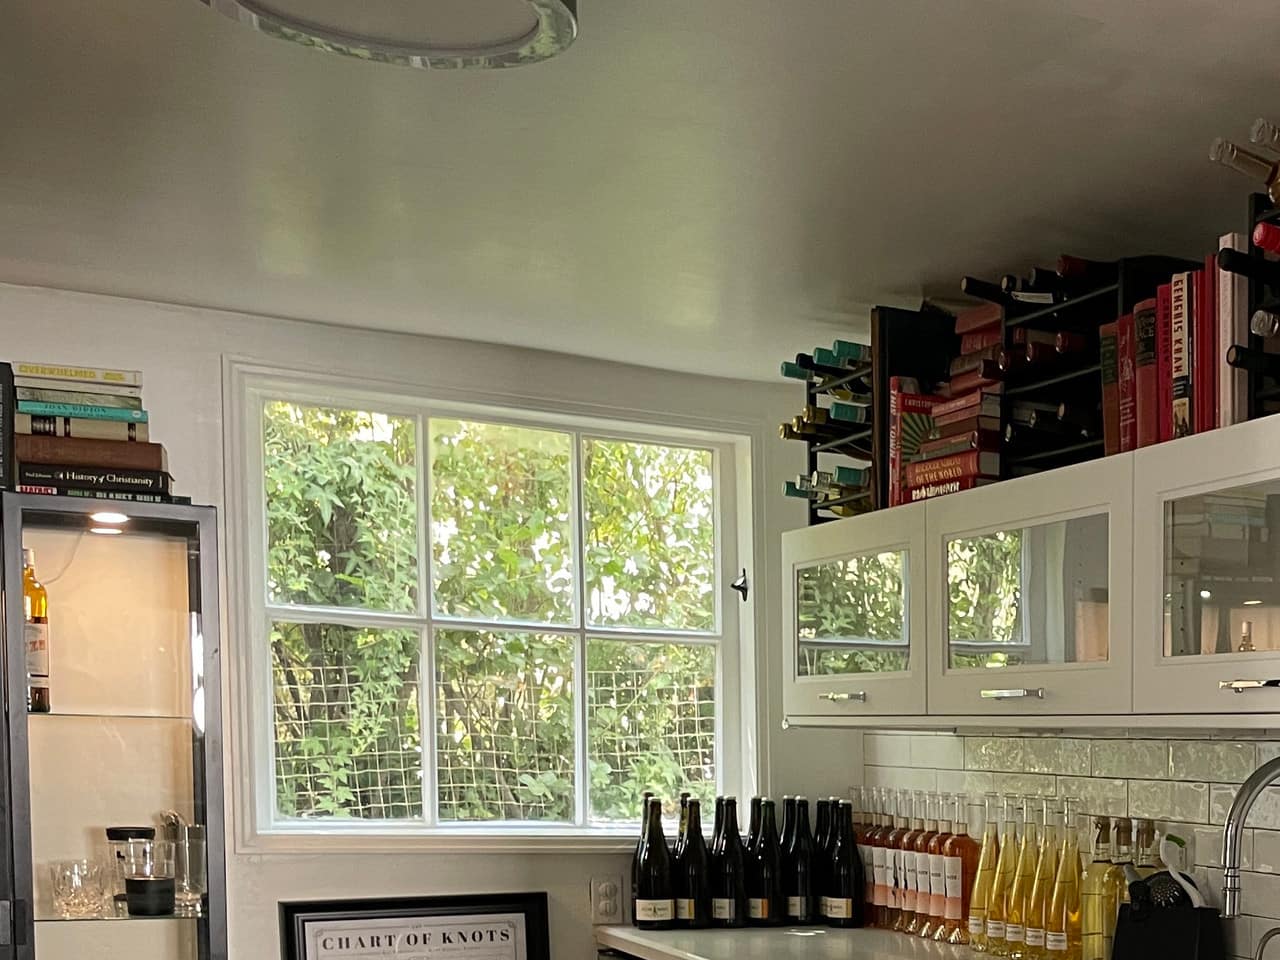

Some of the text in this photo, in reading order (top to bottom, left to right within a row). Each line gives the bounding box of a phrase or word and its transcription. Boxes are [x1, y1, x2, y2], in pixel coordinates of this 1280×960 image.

[1173, 279, 1184, 374] GENGHIS KHAN
[66, 471, 98, 483] History
[106, 473, 154, 486] Christianity
[322, 933, 397, 951] CHART
[406, 931, 432, 946] OF
[441, 928, 511, 946] KNOTS
